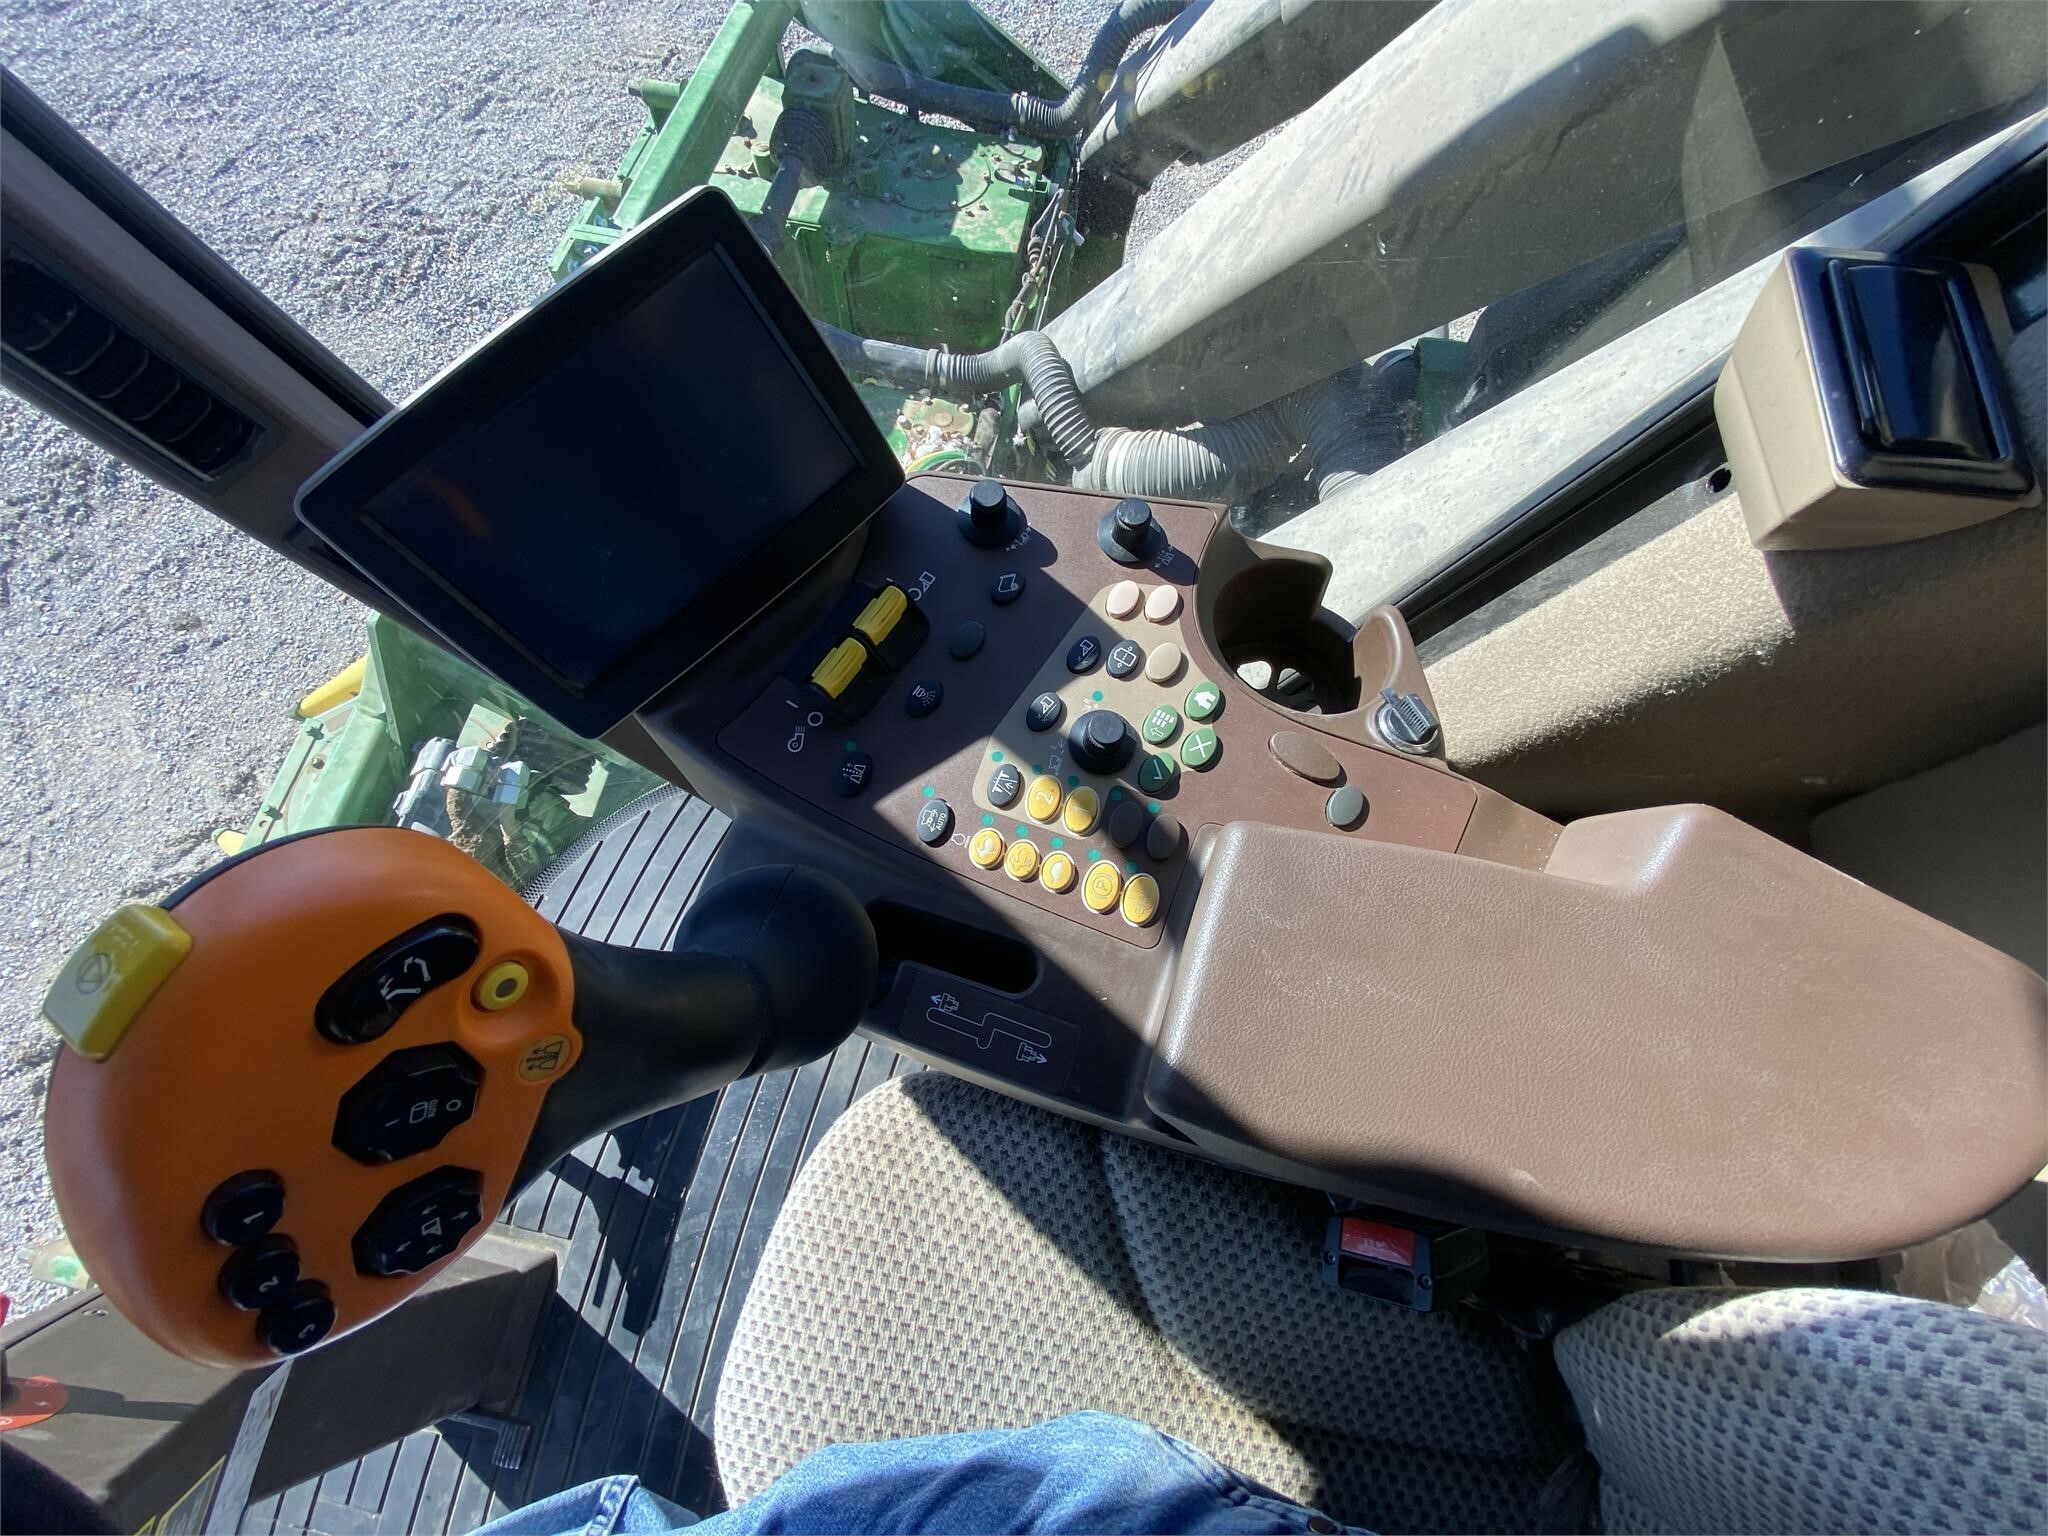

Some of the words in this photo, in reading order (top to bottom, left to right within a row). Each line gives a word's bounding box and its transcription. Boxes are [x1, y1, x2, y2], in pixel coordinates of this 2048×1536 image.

[1036, 791, 1054, 805] 2
[936, 812, 947, 831] AUTO
[241, 1210, 264, 1225] 1
[259, 1274, 281, 1293] 2
